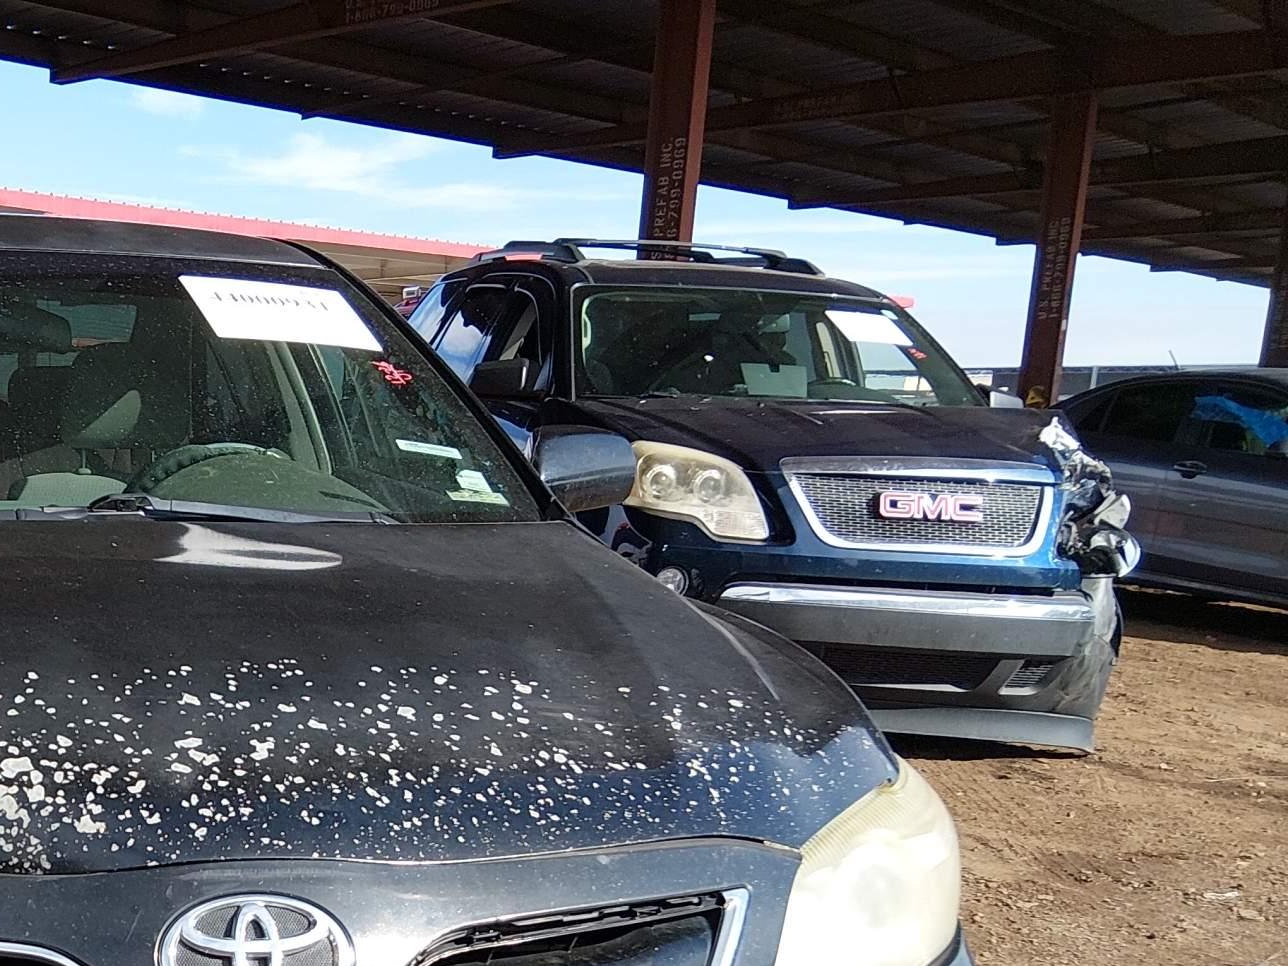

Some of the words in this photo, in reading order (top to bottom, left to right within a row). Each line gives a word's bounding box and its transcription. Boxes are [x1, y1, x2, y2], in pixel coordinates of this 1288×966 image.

[659, 136, 675, 168] INC.
[653, 175, 669, 237] PREFAB
[878, 490, 984, 522] GMC
